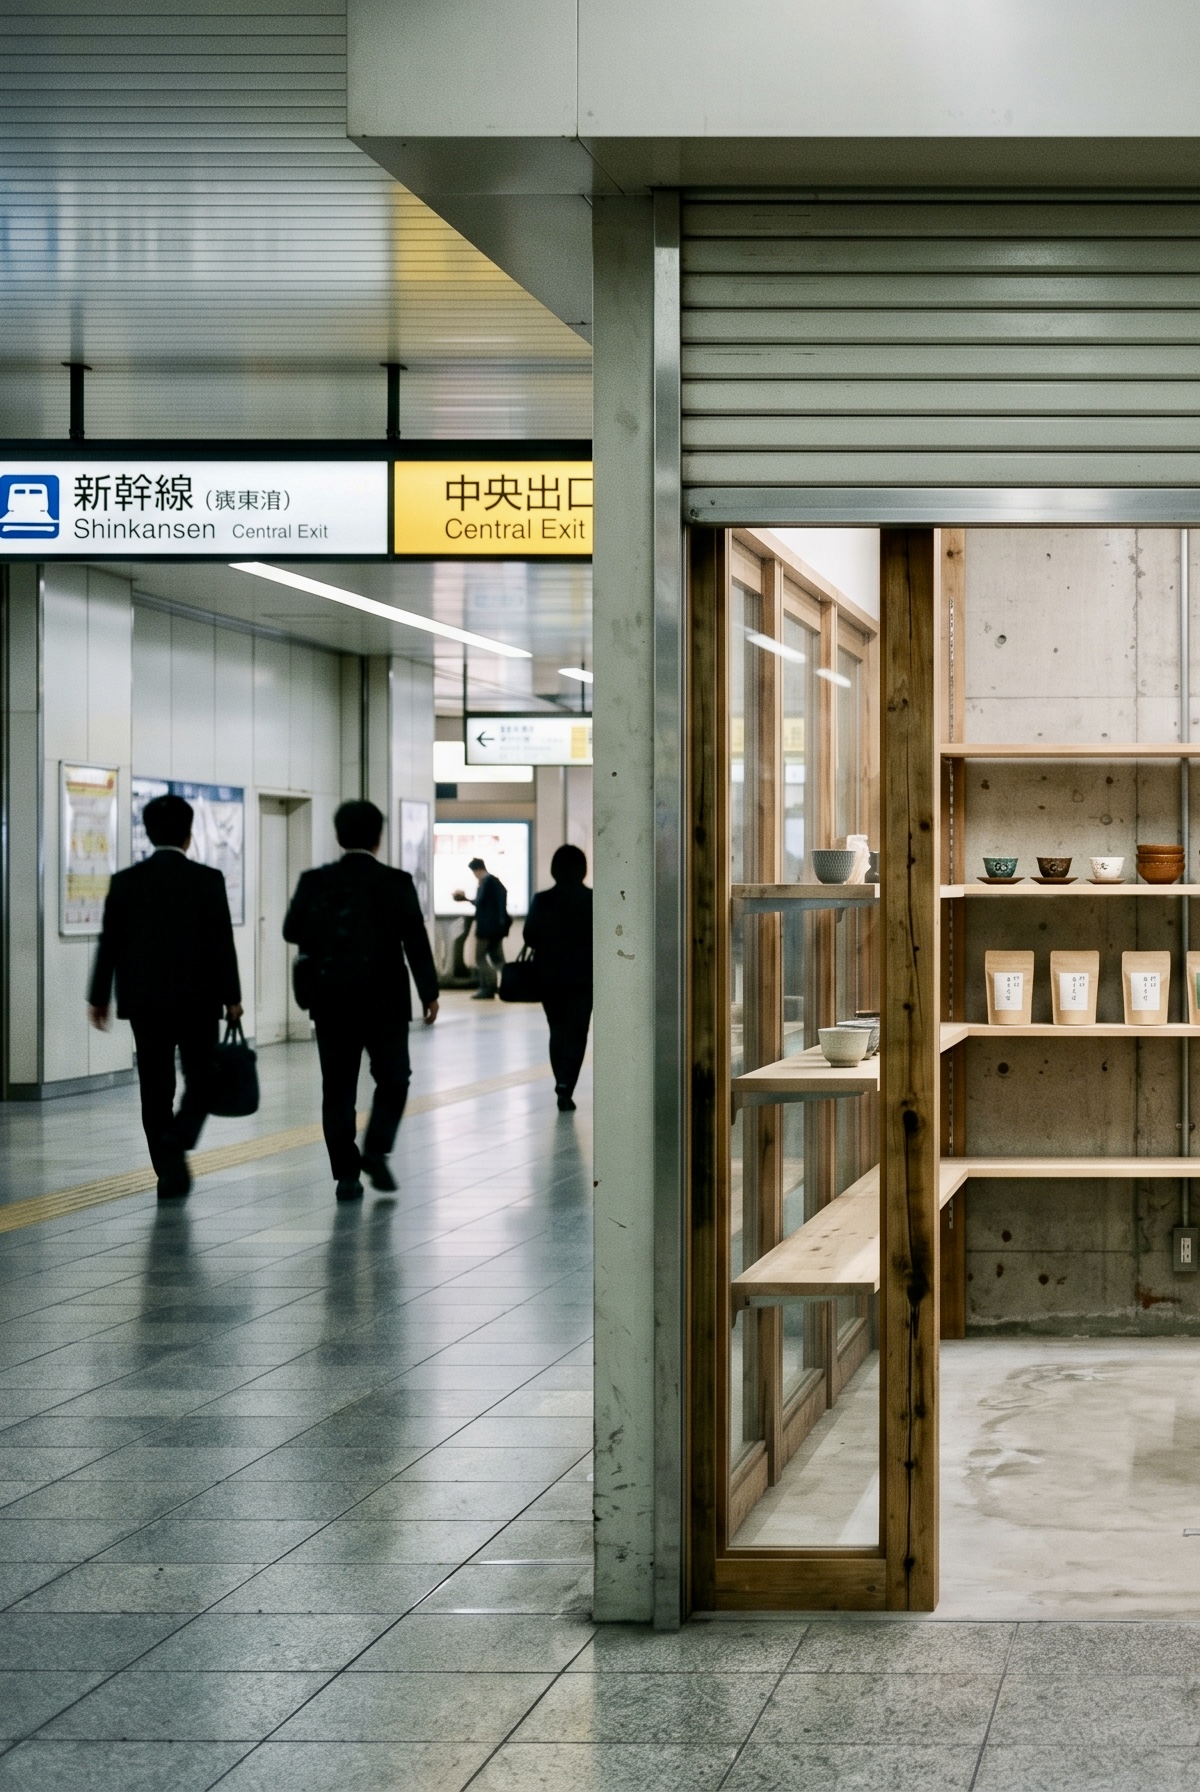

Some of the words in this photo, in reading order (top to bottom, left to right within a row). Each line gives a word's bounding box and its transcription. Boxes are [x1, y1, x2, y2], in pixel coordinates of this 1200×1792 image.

[73, 473, 194, 512] 新幹線
[446, 474, 593, 512] 中央出口
[73, 518, 216, 539] Shinkansen
[232, 523, 292, 539] Central
[298, 523, 328, 539] Exit
[445, 518, 531, 539] Central
[542, 518, 585, 539] Exit
